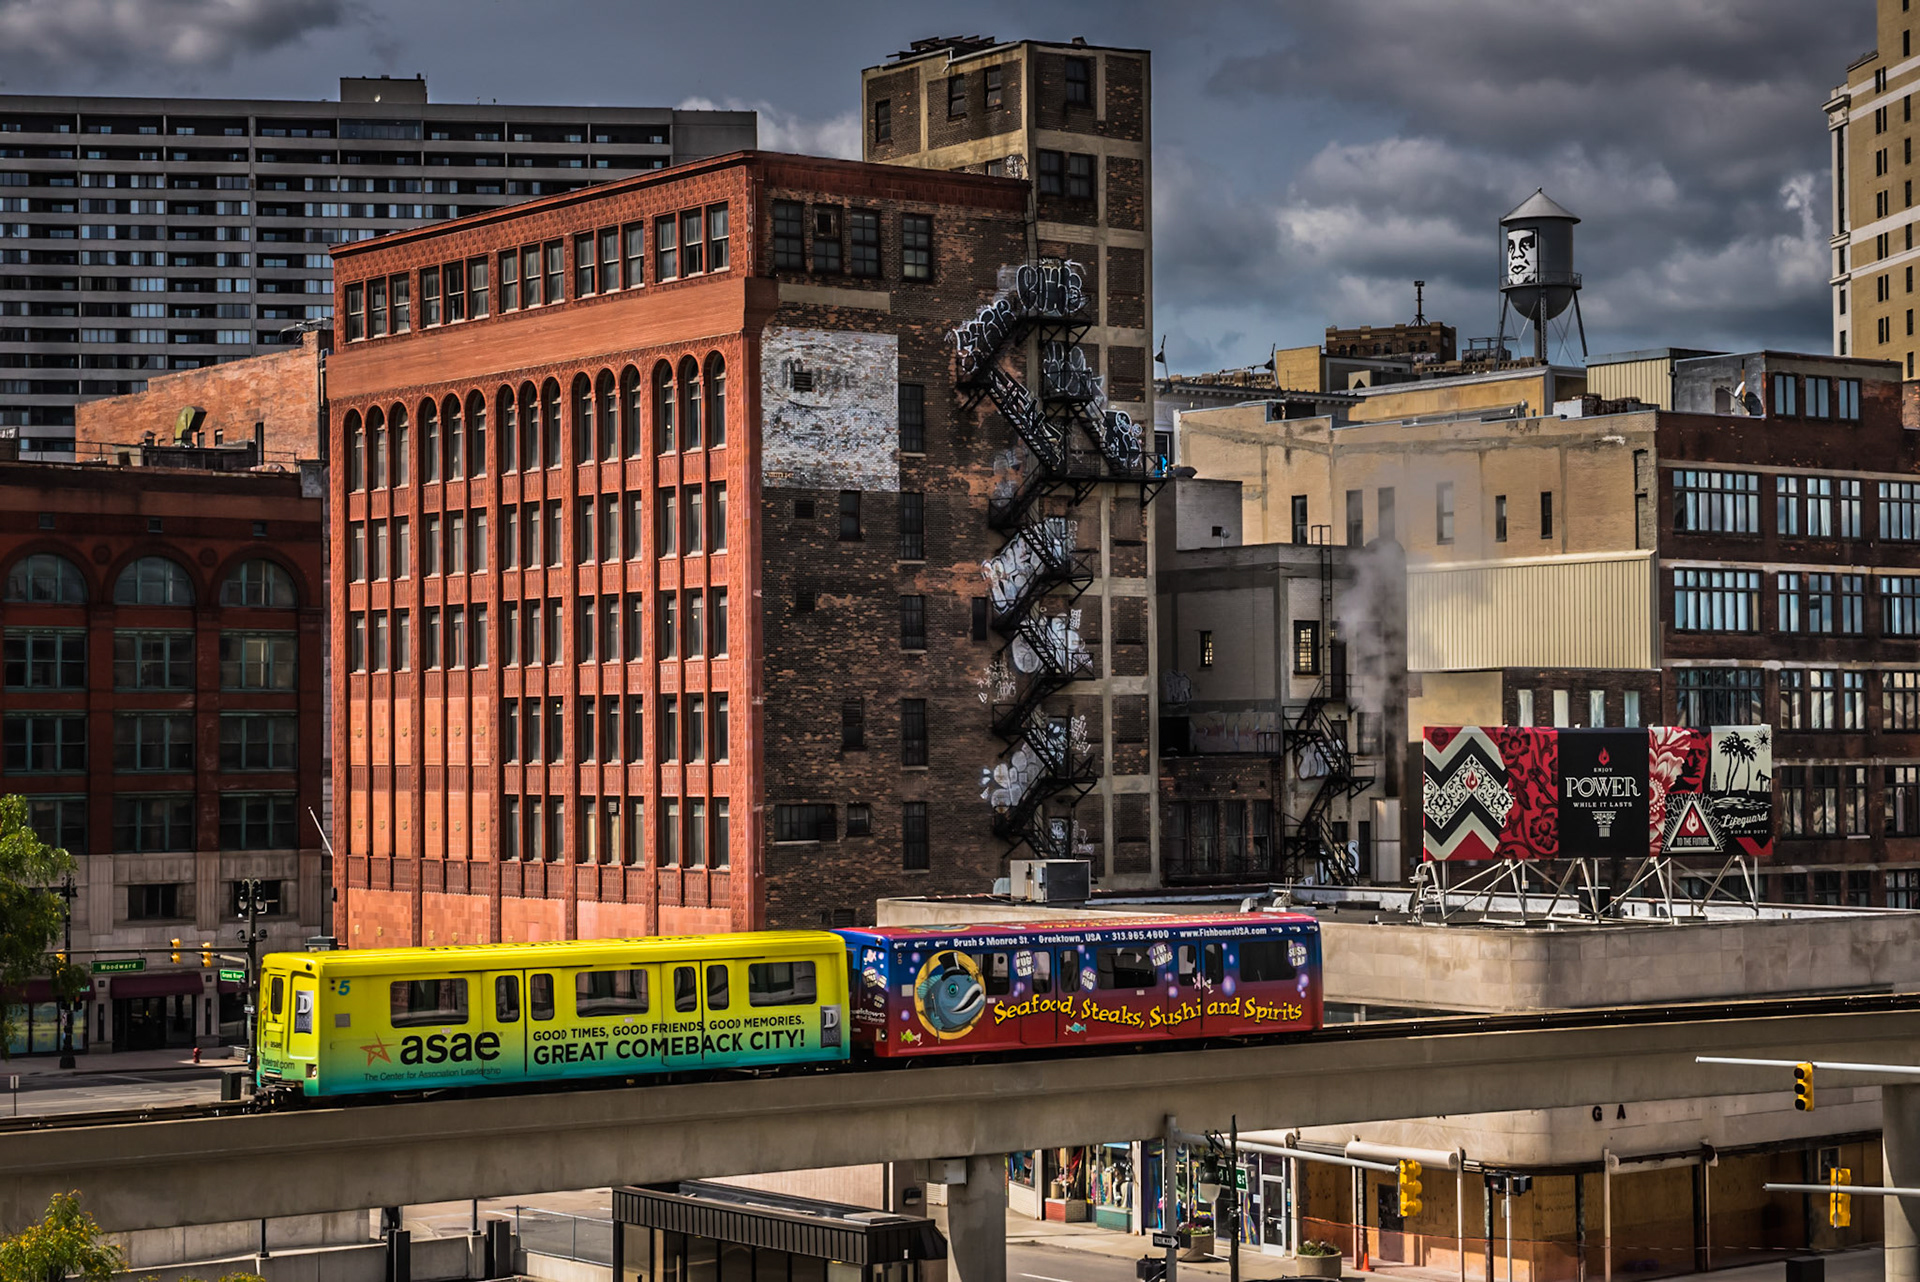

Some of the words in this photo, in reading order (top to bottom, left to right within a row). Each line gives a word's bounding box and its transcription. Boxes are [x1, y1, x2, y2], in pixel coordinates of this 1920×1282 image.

[1565, 776, 1641, 798] POWER
[1720, 811, 1768, 829] Lifeguard
[953, 938, 978, 947] Brush
[986, 936, 1018, 946] Monroe
[1085, 933, 1102, 942] USA
[100, 962, 137, 970] Woodward
[338, 980, 350, 996] 5
[297, 995, 311, 1014] D
[993, 994, 1077, 1025] Seafood,
[1081, 998, 1145, 1029] Steaks,
[1150, 998, 1201, 1028] Sushi
[1206, 997, 1241, 1015] and
[1244, 997, 1302, 1023] Spirits
[533, 1030, 567, 1041] GOOD
[571, 1027, 609, 1039] TIMES,
[613, 1024, 648, 1036] GOOD
[651, 1021, 706, 1034] FRIENDS,
[709, 1018, 741, 1030] GOOD
[744, 1015, 805, 1028] MEMORIES.
[823, 1010, 839, 1028] D
[400, 1032, 500, 1065] asae
[533, 1041, 608, 1065] GREAT
[616, 1032, 743, 1059] COMEBACK
[750, 1028, 805, 1051] CITY!
[364, 1073, 379, 1081] The
[380, 1071, 404, 1080] Center
[406, 1071, 417, 1079] for
[419, 1069, 458, 1078] Association
[461, 1067, 501, 1077] Leadership
[1592, 1105, 1602, 1122] G
[1616, 1104, 1626, 1120] A
